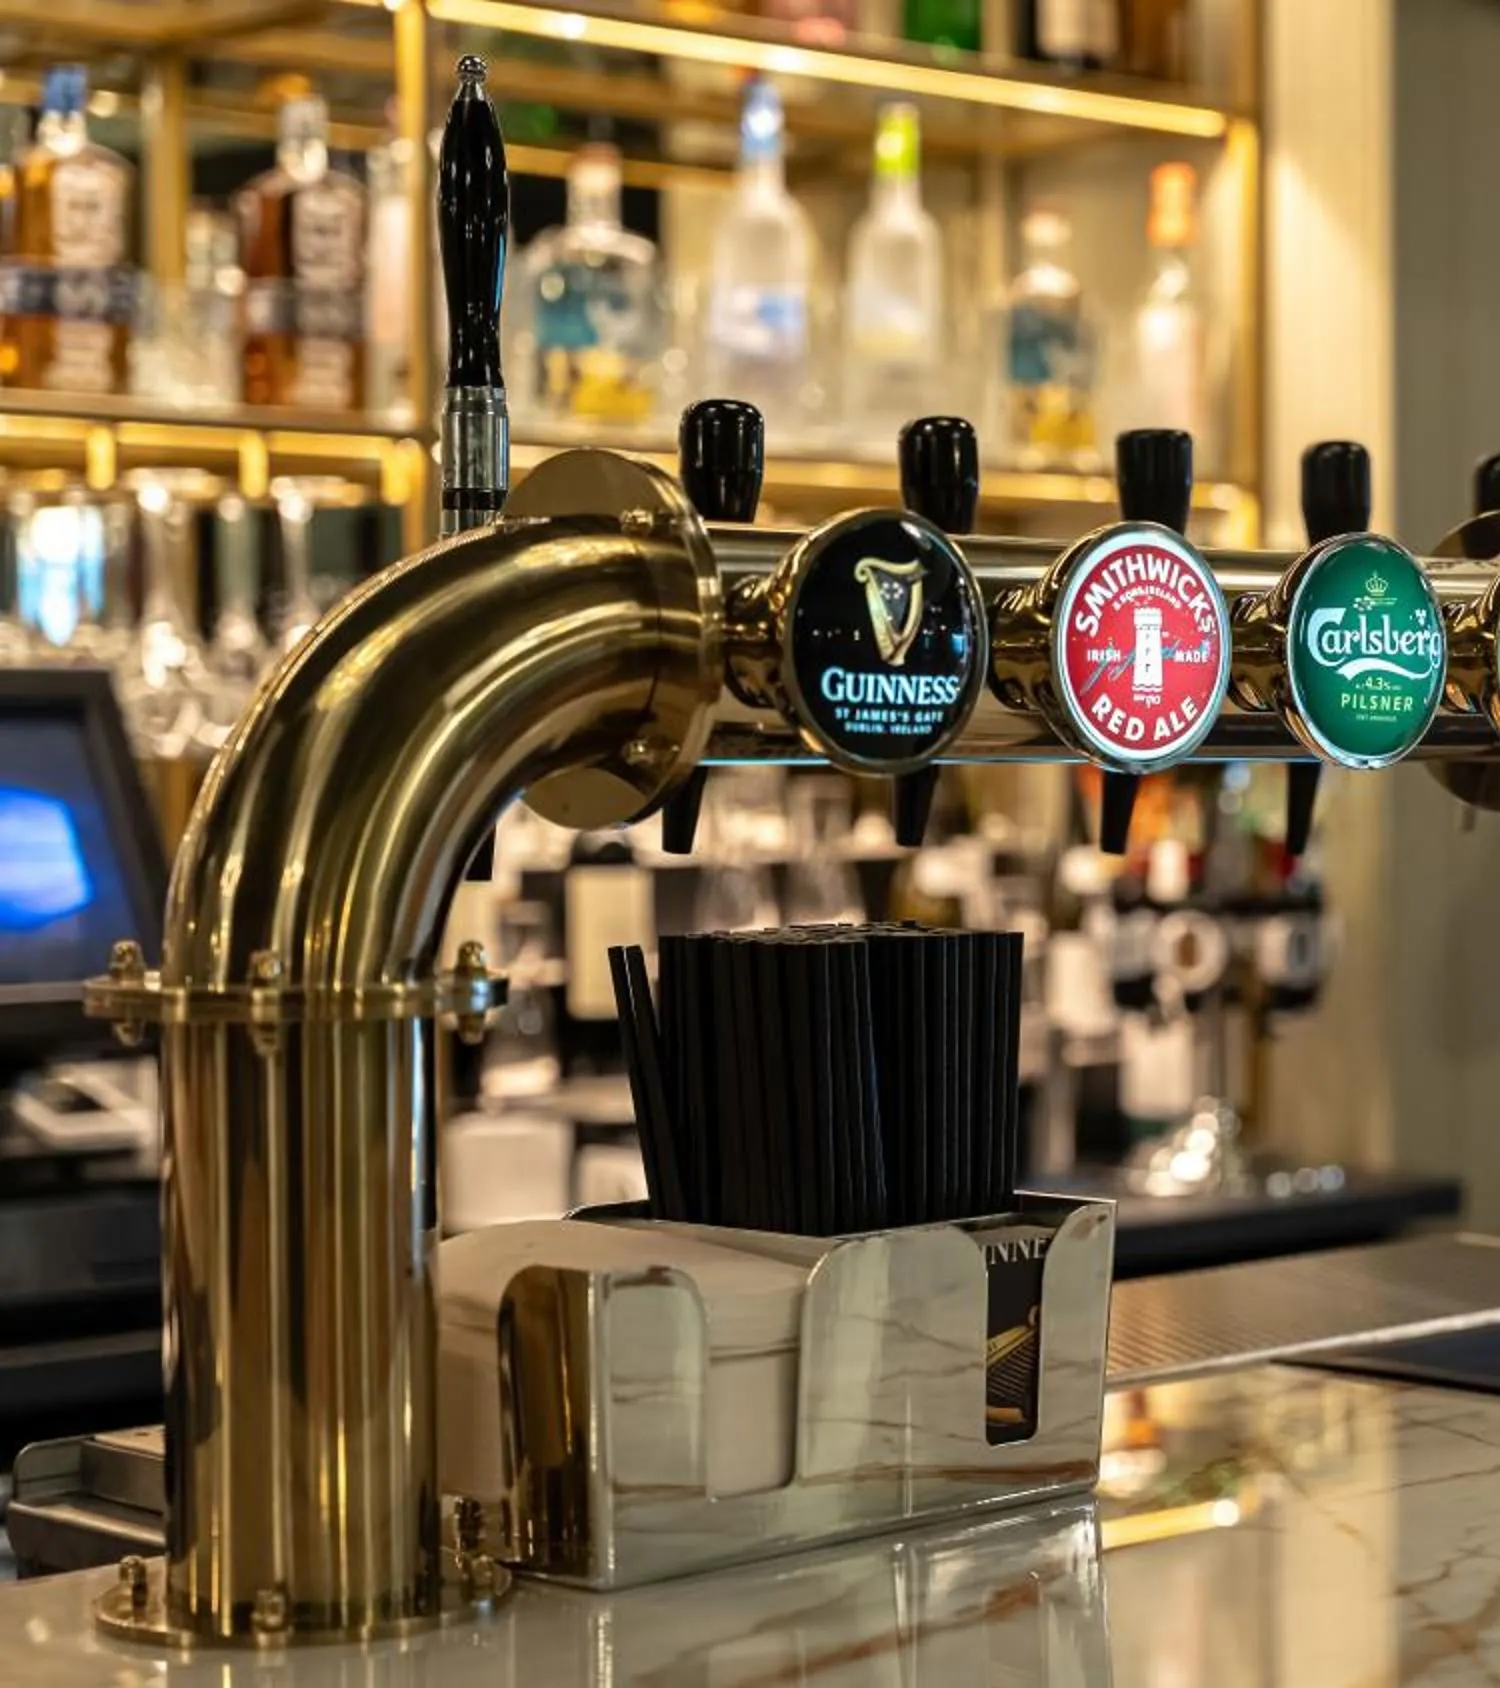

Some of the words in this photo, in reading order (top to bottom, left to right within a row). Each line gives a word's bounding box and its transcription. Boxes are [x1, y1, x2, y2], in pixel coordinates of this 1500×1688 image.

[1087, 649, 1121, 662] IRISH
[1174, 650, 1208, 662] MADE
[1307, 608, 1442, 668] Carlsberg
[821, 666, 960, 705] GUINNESS
[1341, 692, 1413, 712] PILSNER
[1092, 693, 1145, 741] RED
[1153, 696, 1198, 741] ALE
